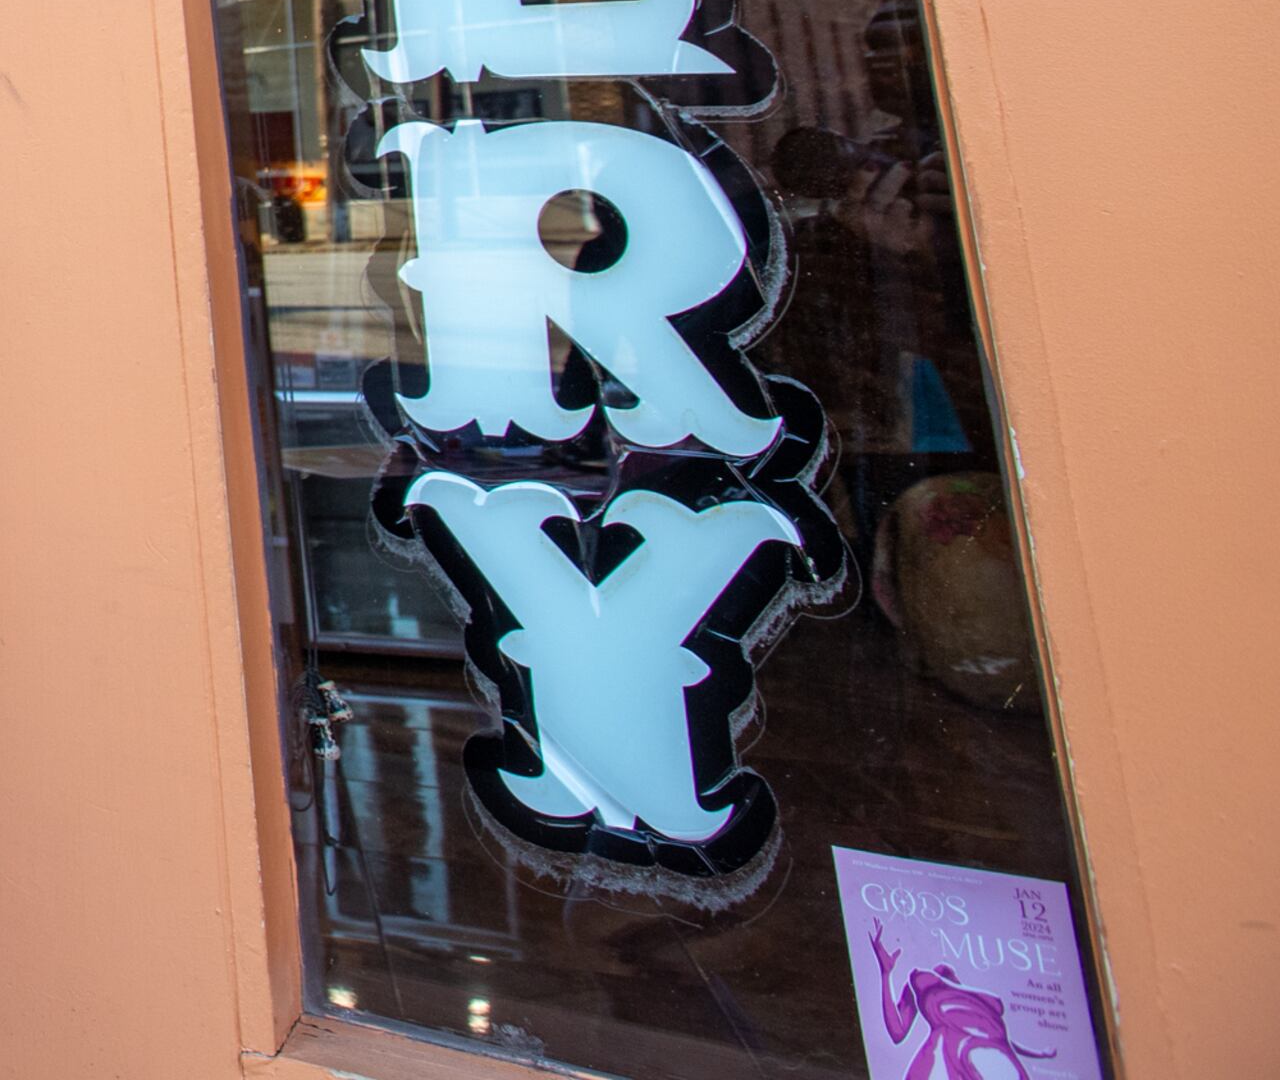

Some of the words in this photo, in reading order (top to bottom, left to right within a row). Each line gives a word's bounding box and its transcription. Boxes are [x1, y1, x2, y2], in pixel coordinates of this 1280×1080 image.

[1013, 887, 1042, 901] JAN
[1019, 900, 1048, 923] 12
[931, 927, 1062, 978] MUSE
[1046, 981, 1062, 993] all
[1009, 1003, 1046, 1017] group
